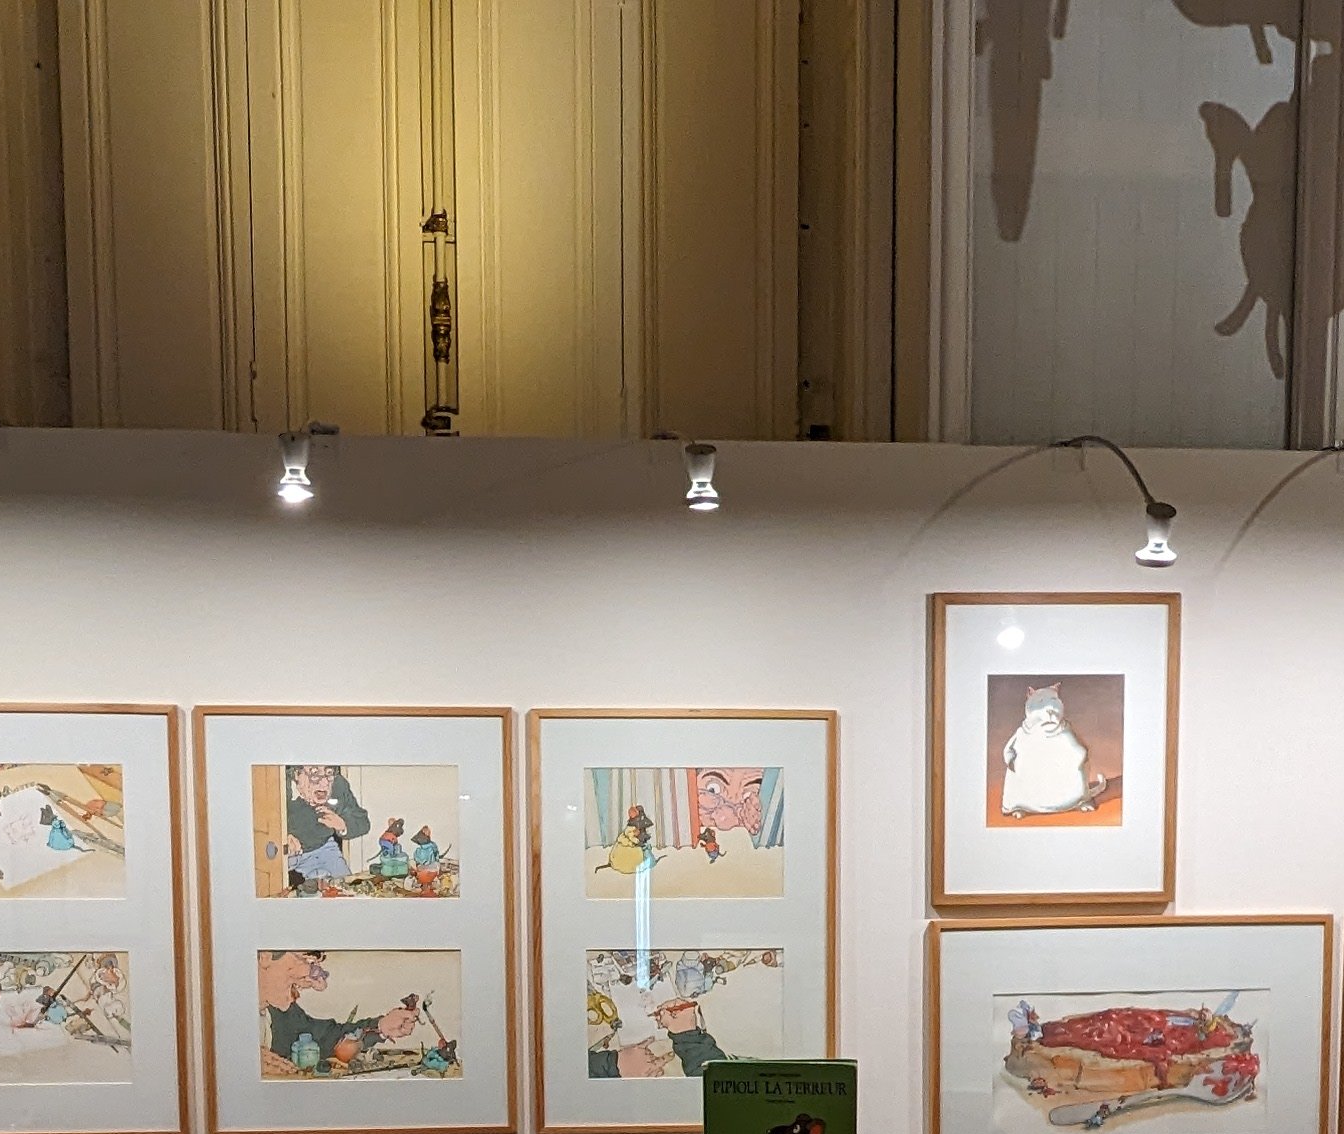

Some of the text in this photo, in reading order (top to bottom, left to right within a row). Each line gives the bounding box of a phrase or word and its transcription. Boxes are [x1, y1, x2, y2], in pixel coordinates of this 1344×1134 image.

[713, 1080, 847, 1096] PIPIOLI LA TERREUR
